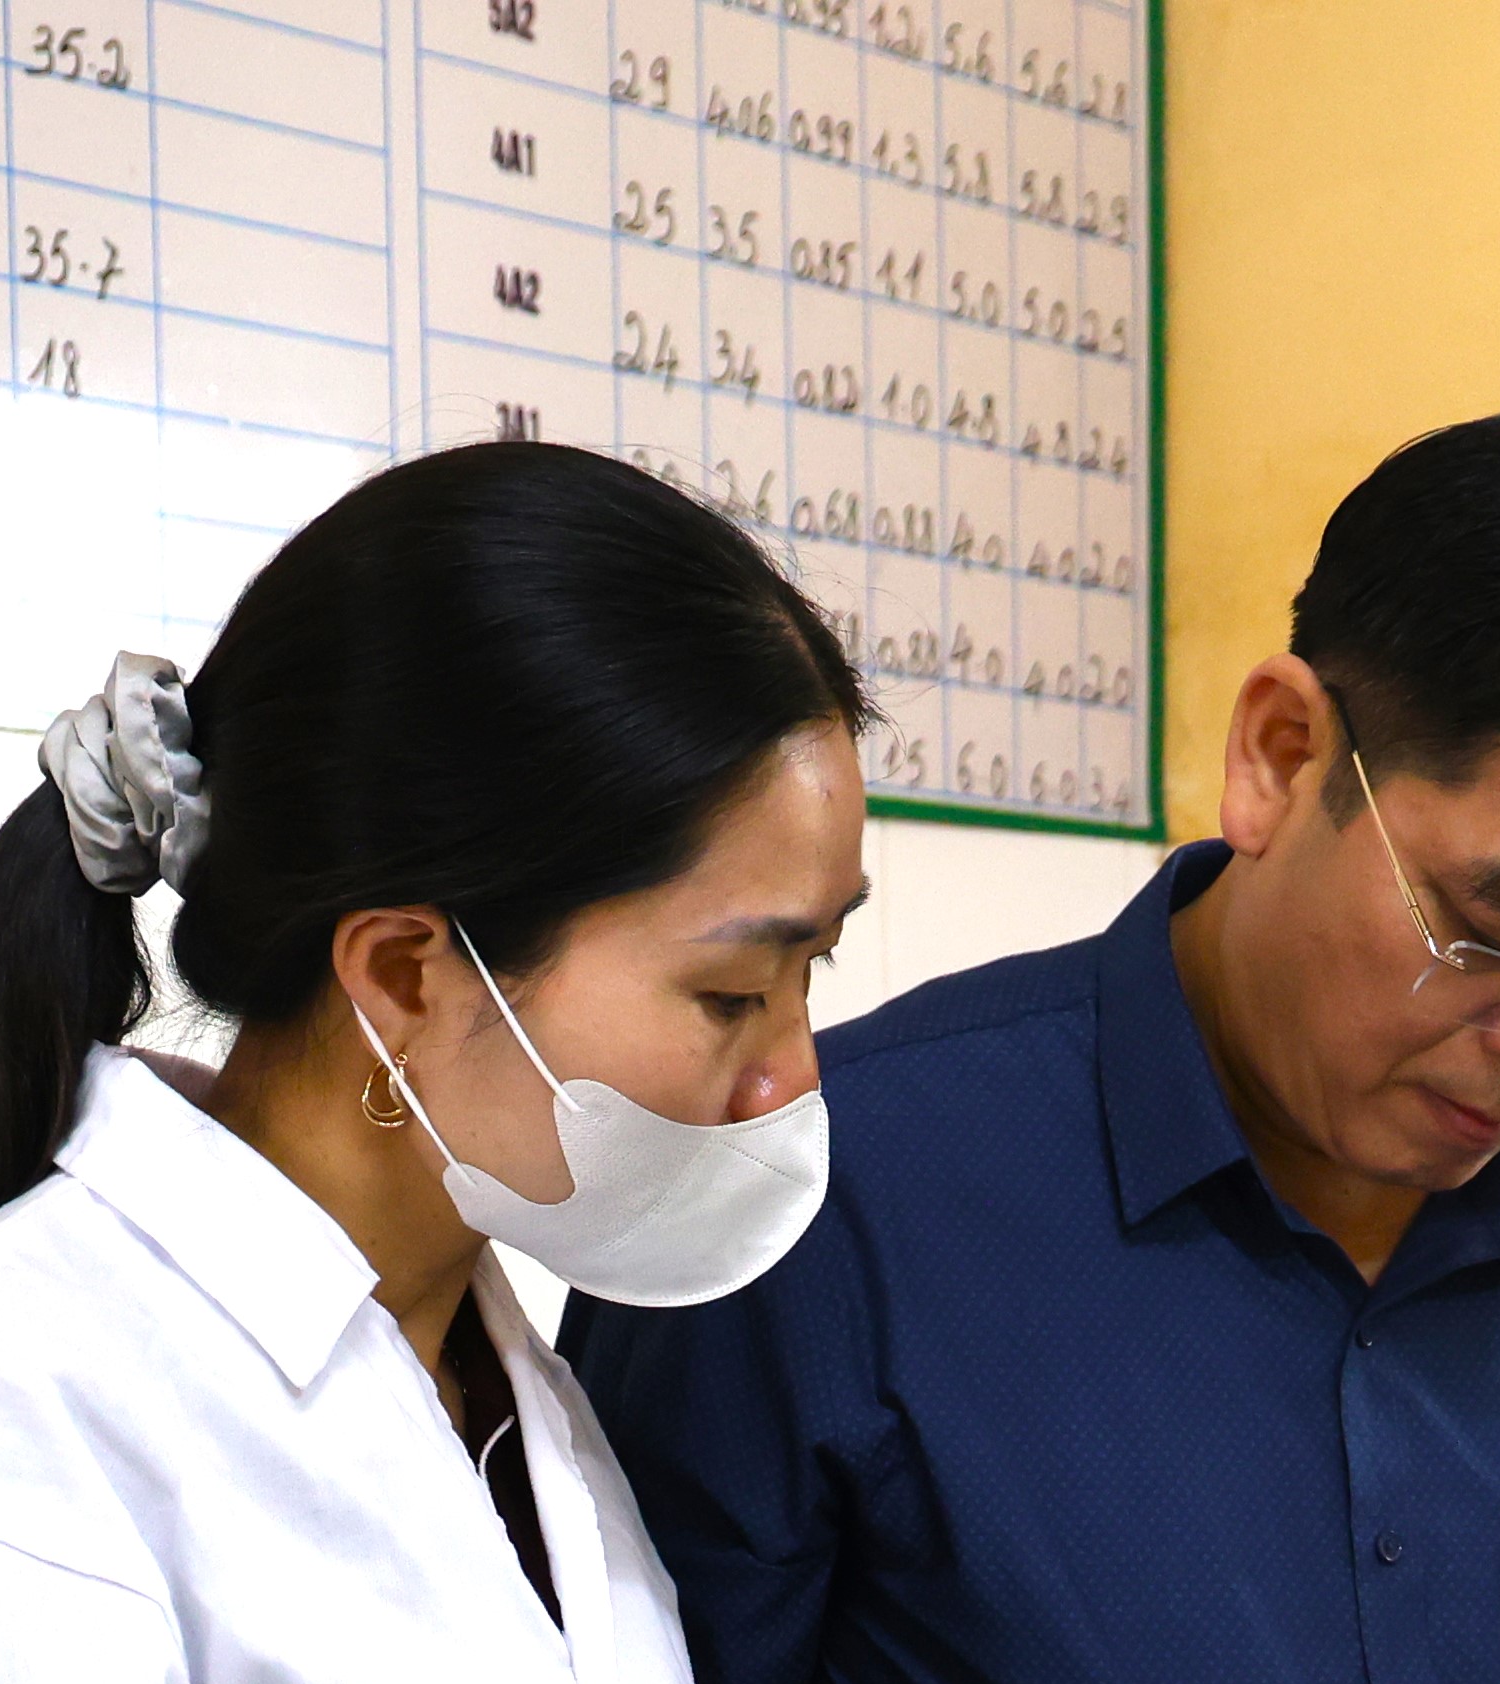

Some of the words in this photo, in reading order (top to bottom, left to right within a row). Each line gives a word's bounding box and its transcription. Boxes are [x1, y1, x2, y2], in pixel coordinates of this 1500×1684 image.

[609, 49, 672, 112] 29
[612, 180, 676, 248] 25
[612, 309, 680, 394] 24
